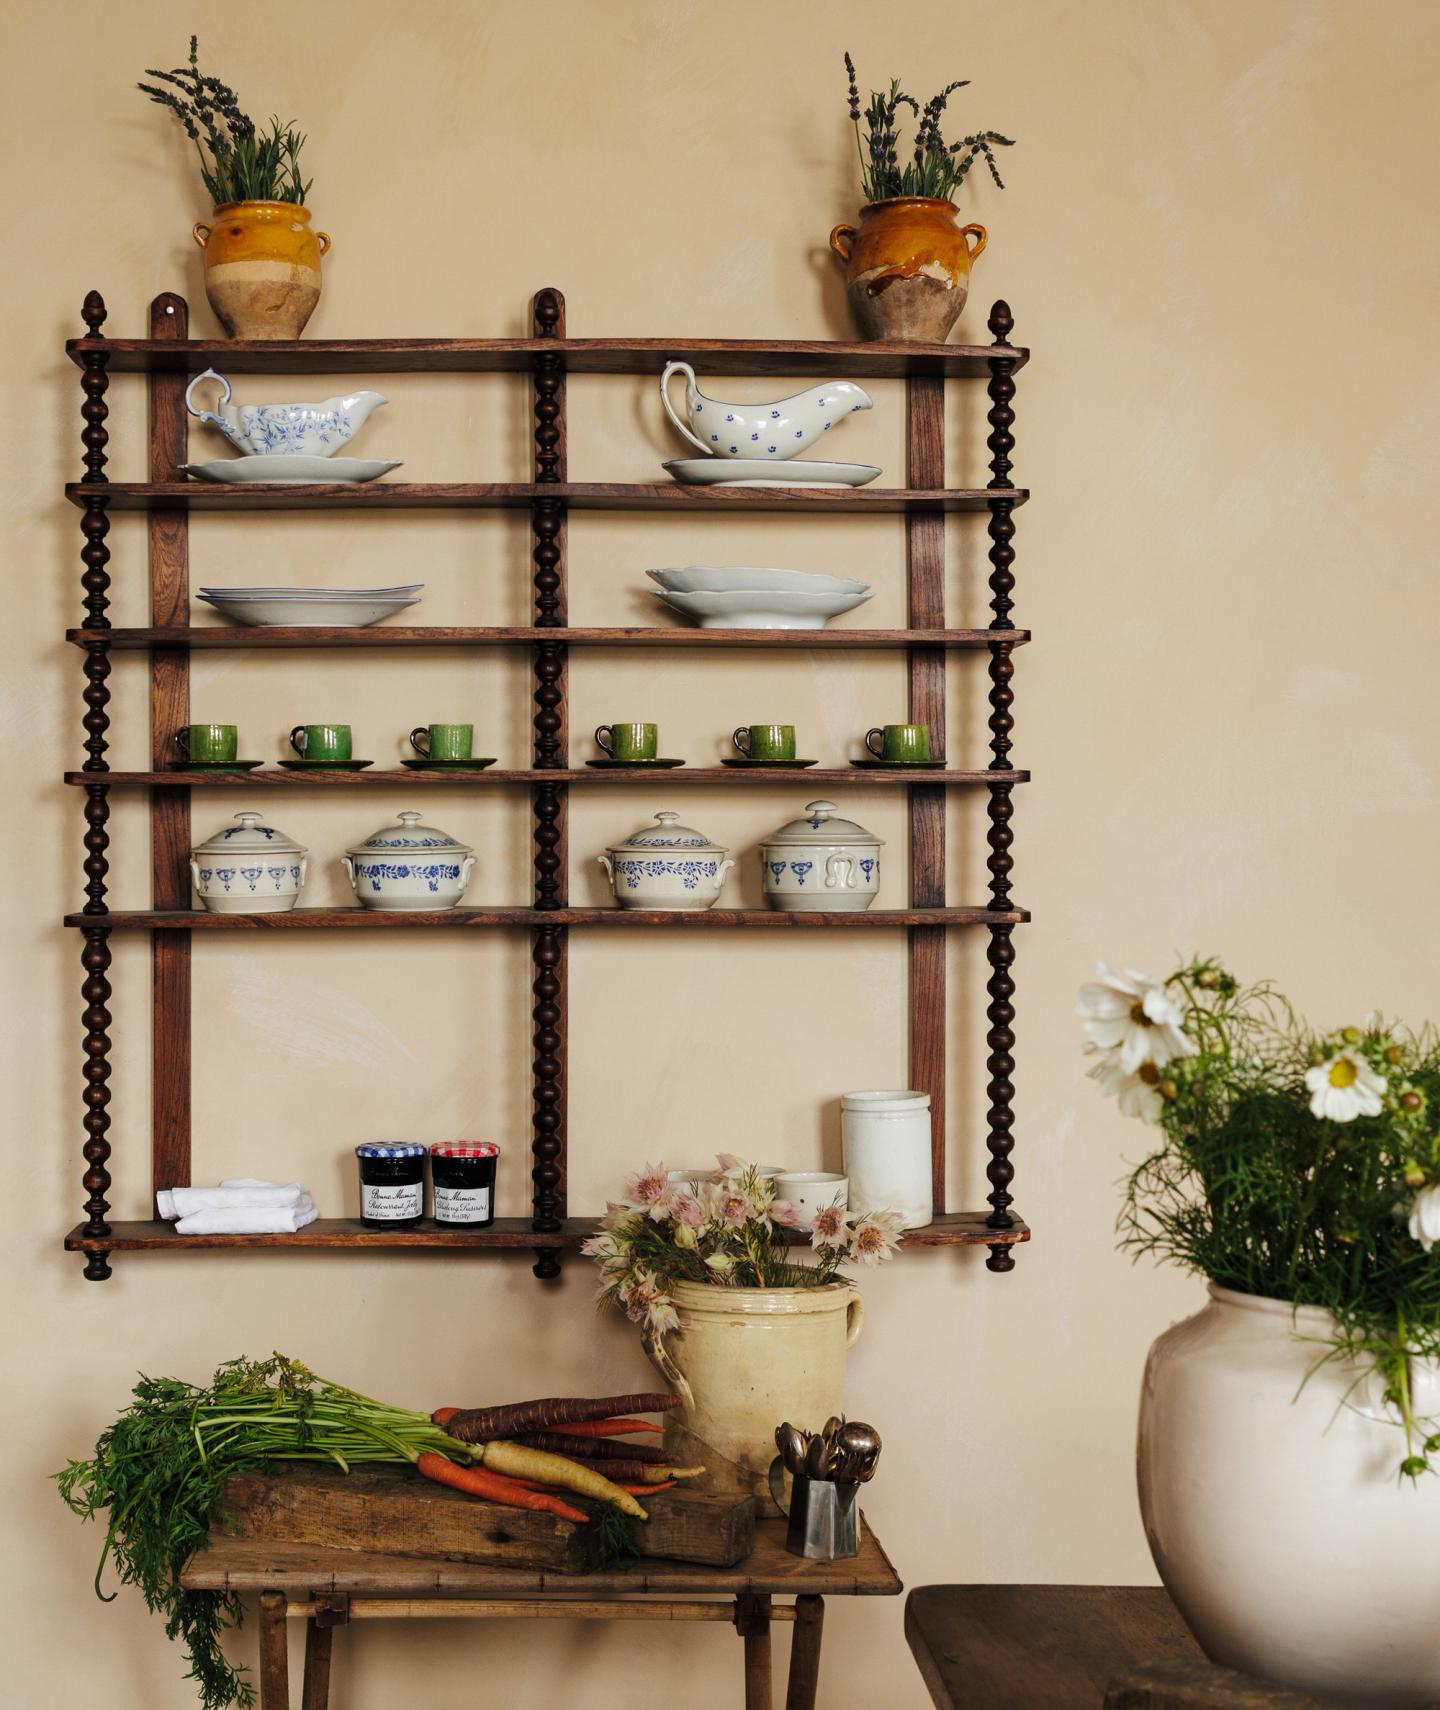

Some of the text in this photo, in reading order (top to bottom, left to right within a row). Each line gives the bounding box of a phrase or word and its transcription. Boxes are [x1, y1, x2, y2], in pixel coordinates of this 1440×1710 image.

[371, 1188, 416, 1199] Bonne Maman
[449, 1191, 477, 1201] Maman
